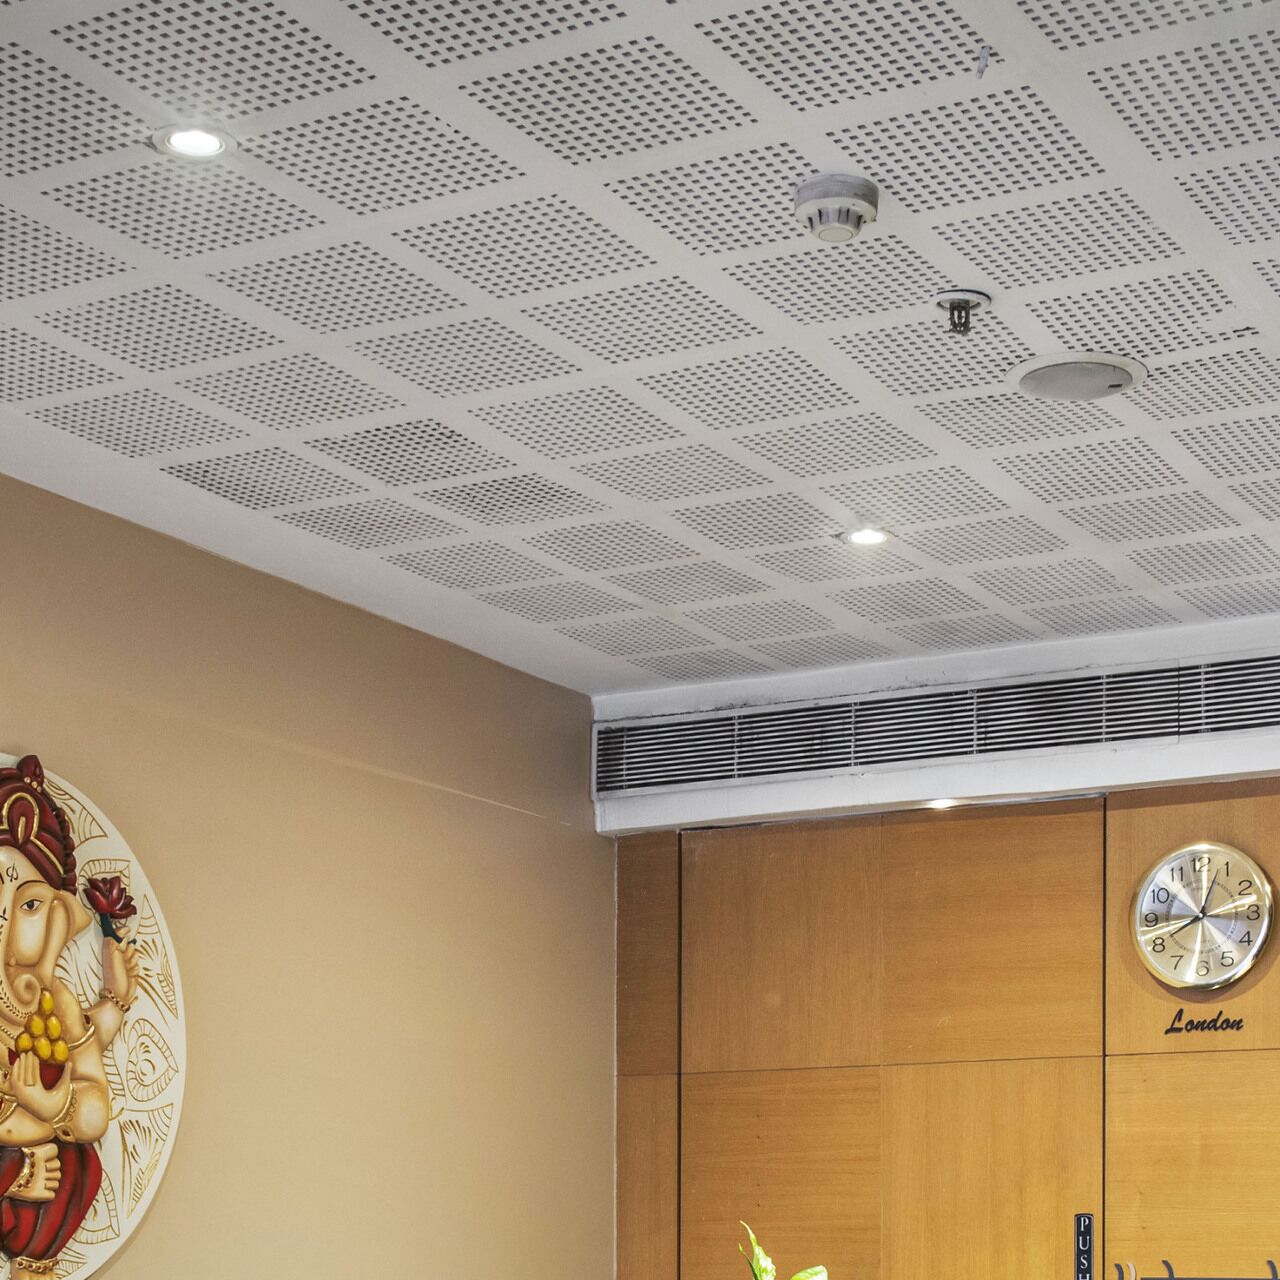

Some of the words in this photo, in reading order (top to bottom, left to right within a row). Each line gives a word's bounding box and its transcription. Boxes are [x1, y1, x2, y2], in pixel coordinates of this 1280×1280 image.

[1191, 857, 1211, 873] 12
[1224, 861, 1230, 877] 1
[1170, 866, 1184, 882] 11
[1238, 879, 1252, 895] 2
[1152, 887, 1170, 904] 10
[1144, 912, 1158, 928] 9
[1246, 904, 1260, 921] 3
[1152, 937, 1166, 953] 8
[1239, 931, 1253, 946] 4
[1170, 955, 1184, 971] 7
[1220, 950, 1234, 967] 5
[1196, 961, 1209, 977] 6
[1164, 1008, 1244, 1035] London
